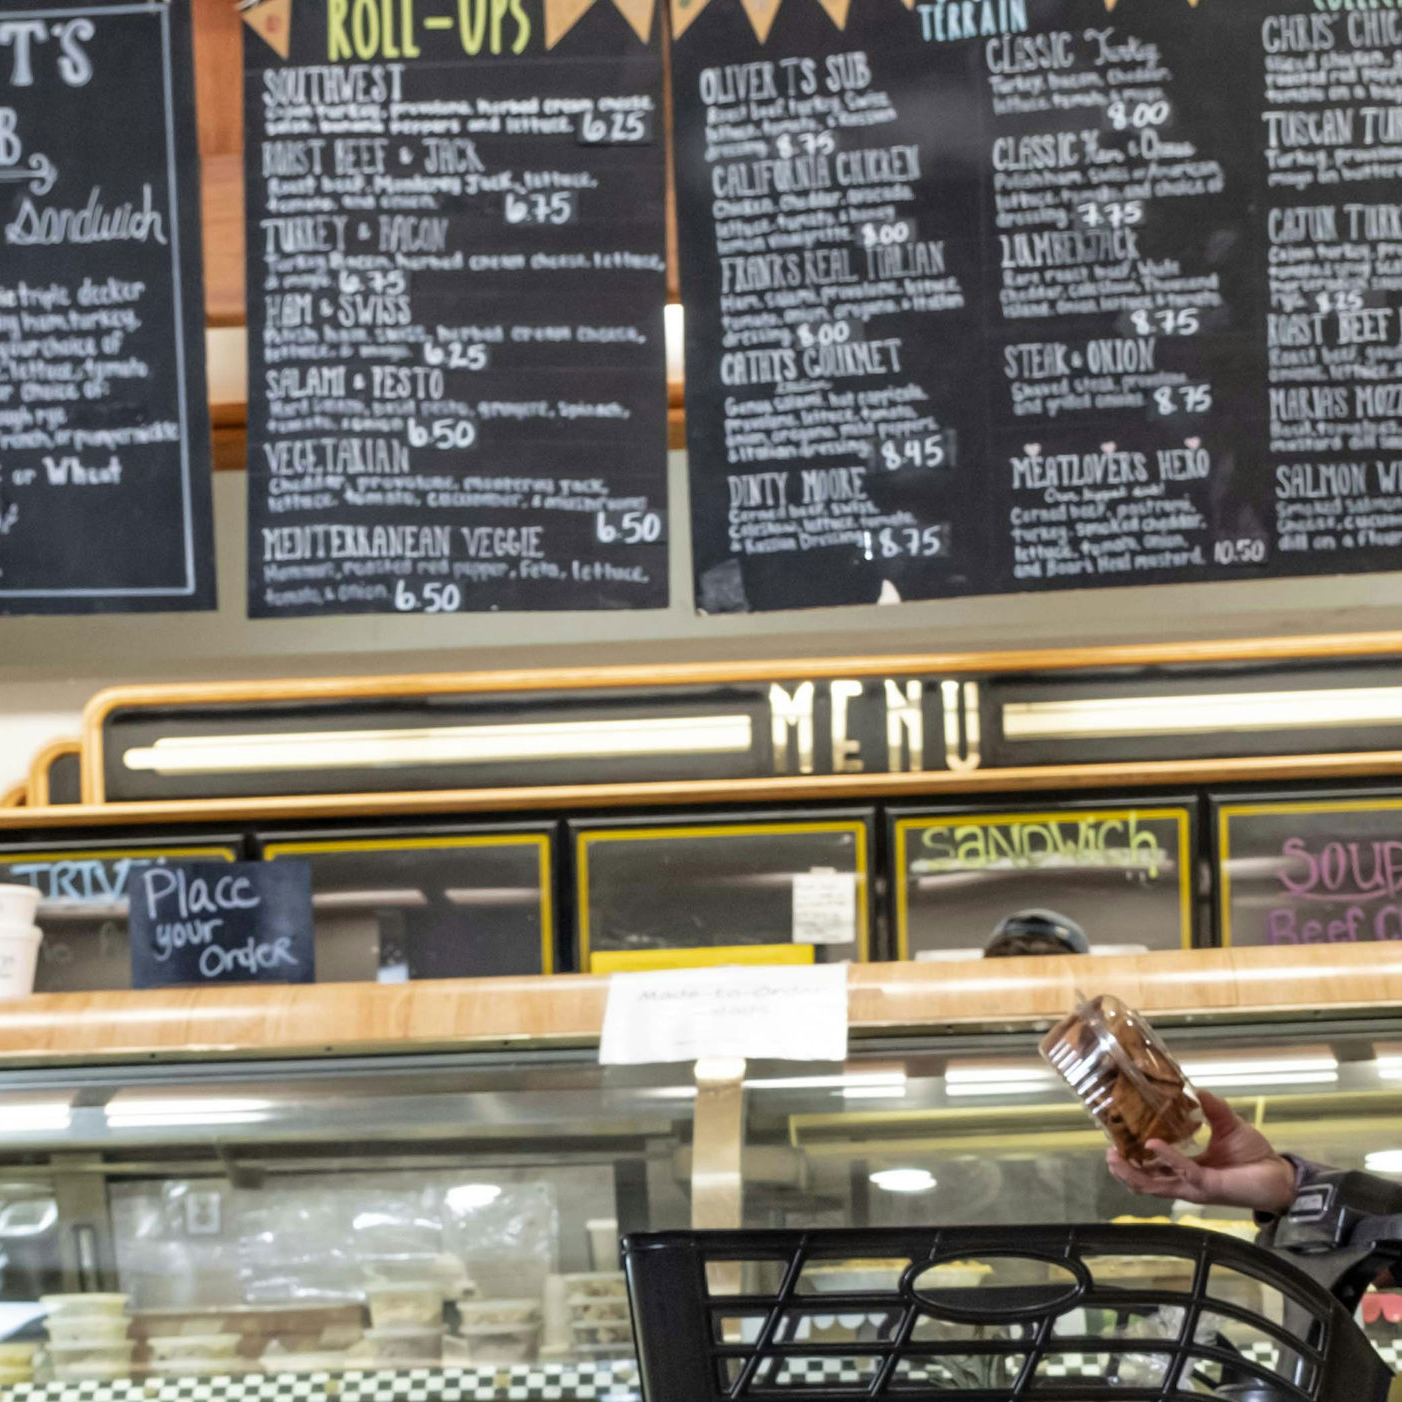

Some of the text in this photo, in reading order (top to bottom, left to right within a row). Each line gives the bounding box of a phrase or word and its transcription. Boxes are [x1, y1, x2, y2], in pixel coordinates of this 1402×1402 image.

[917, 1, 1028, 42] TERRAIN
[986, 31, 1074, 74] CLASSIC
[264, 65, 405, 104] SOUTHWEST
[700, 60, 777, 105] OLIVER
[826, 51, 872, 92] SUB
[1262, 109, 1354, 147] TUSCAN
[263, 138, 485, 177] ROAST BEEF JACK
[992, 132, 1079, 171] CLASSIC
[712, 145, 921, 198] CALIFORNIA CHICKEN
[261, 216, 448, 253] TURKEY BACON
[1268, 205, 1338, 243] CAJUN
[801, 241, 945, 286] REAL ITALIAN
[1000, 227, 1139, 268] LUMBERJACK
[266, 294, 411, 327] HAM SWISS
[1267, 313, 1327, 347] ROAST
[1338, 308, 1393, 344] BEEF
[803, 338, 902, 378] GOURMET
[1005, 337, 1155, 379] STEAK ONION
[266, 366, 444, 399] SALAMI PESTO
[12, 469, 36, 486] or
[43, 456, 121, 486] Wheat
[265, 438, 409, 474] VEGETARIAN
[1010, 449, 1210, 489] MEATLOVERS HERO
[802, 467, 867, 503] MOORE
[1276, 462, 1367, 498] SALMON
[263, 526, 543, 560] MEDITERRANEAN VEGGIE
[769, 679, 981, 774] MENU
[9, 858, 168, 903] TRIV
[142, 867, 261, 922] Place
[155, 919, 222, 961] your
[1267, 907, 1362, 944] Beef
